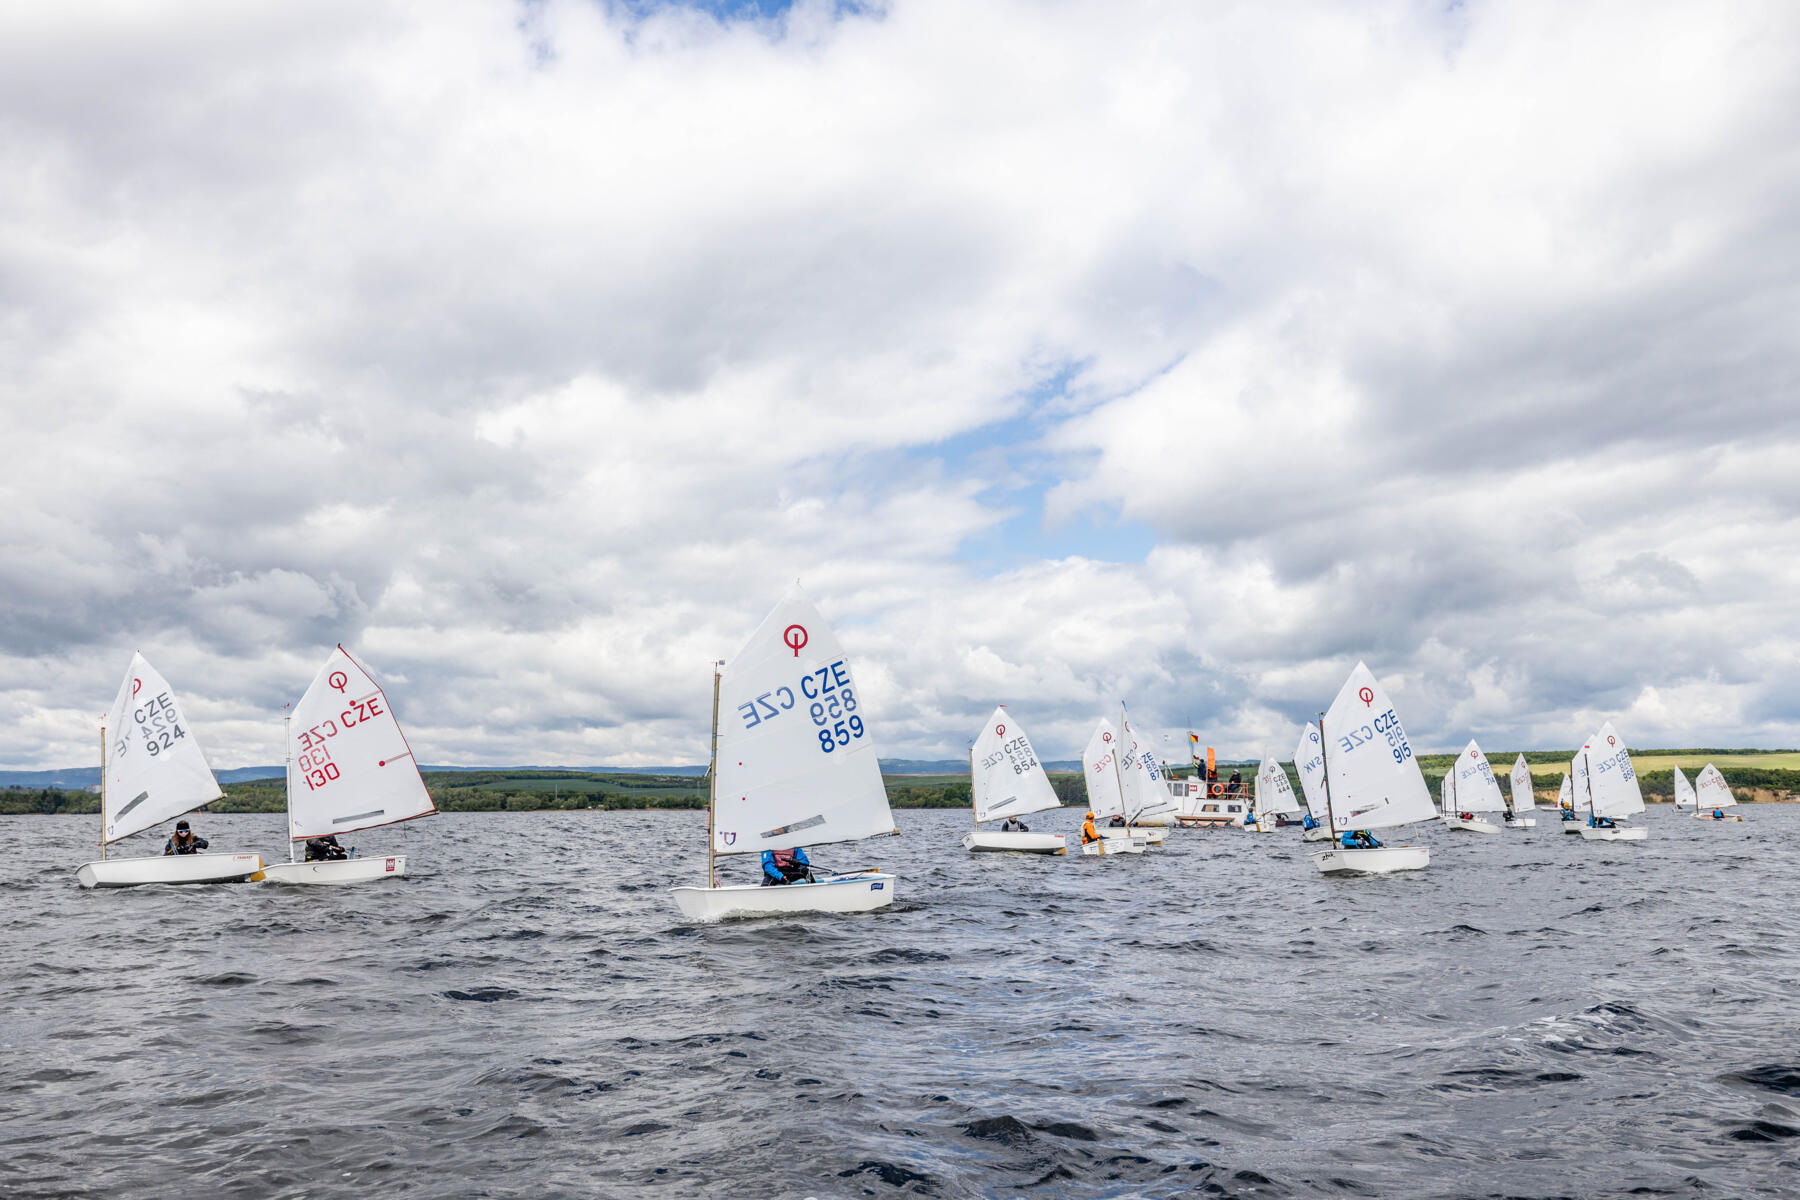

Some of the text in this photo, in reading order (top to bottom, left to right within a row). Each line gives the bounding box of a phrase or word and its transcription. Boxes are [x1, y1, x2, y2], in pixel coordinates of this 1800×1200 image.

[801, 660, 850, 699] CZE
[134, 691, 173, 724] CZE
[341, 698, 384, 728] CZE
[1374, 709, 1399, 734] CZE
[146, 724, 186, 757] 924
[818, 715, 864, 753] 859
[1004, 736, 1028, 755] CZE
[1013, 757, 1038, 775] 854
[1393, 742, 1412, 764] 915
[305, 762, 340, 791] 130
[1273, 773, 1286, 783] CZE
